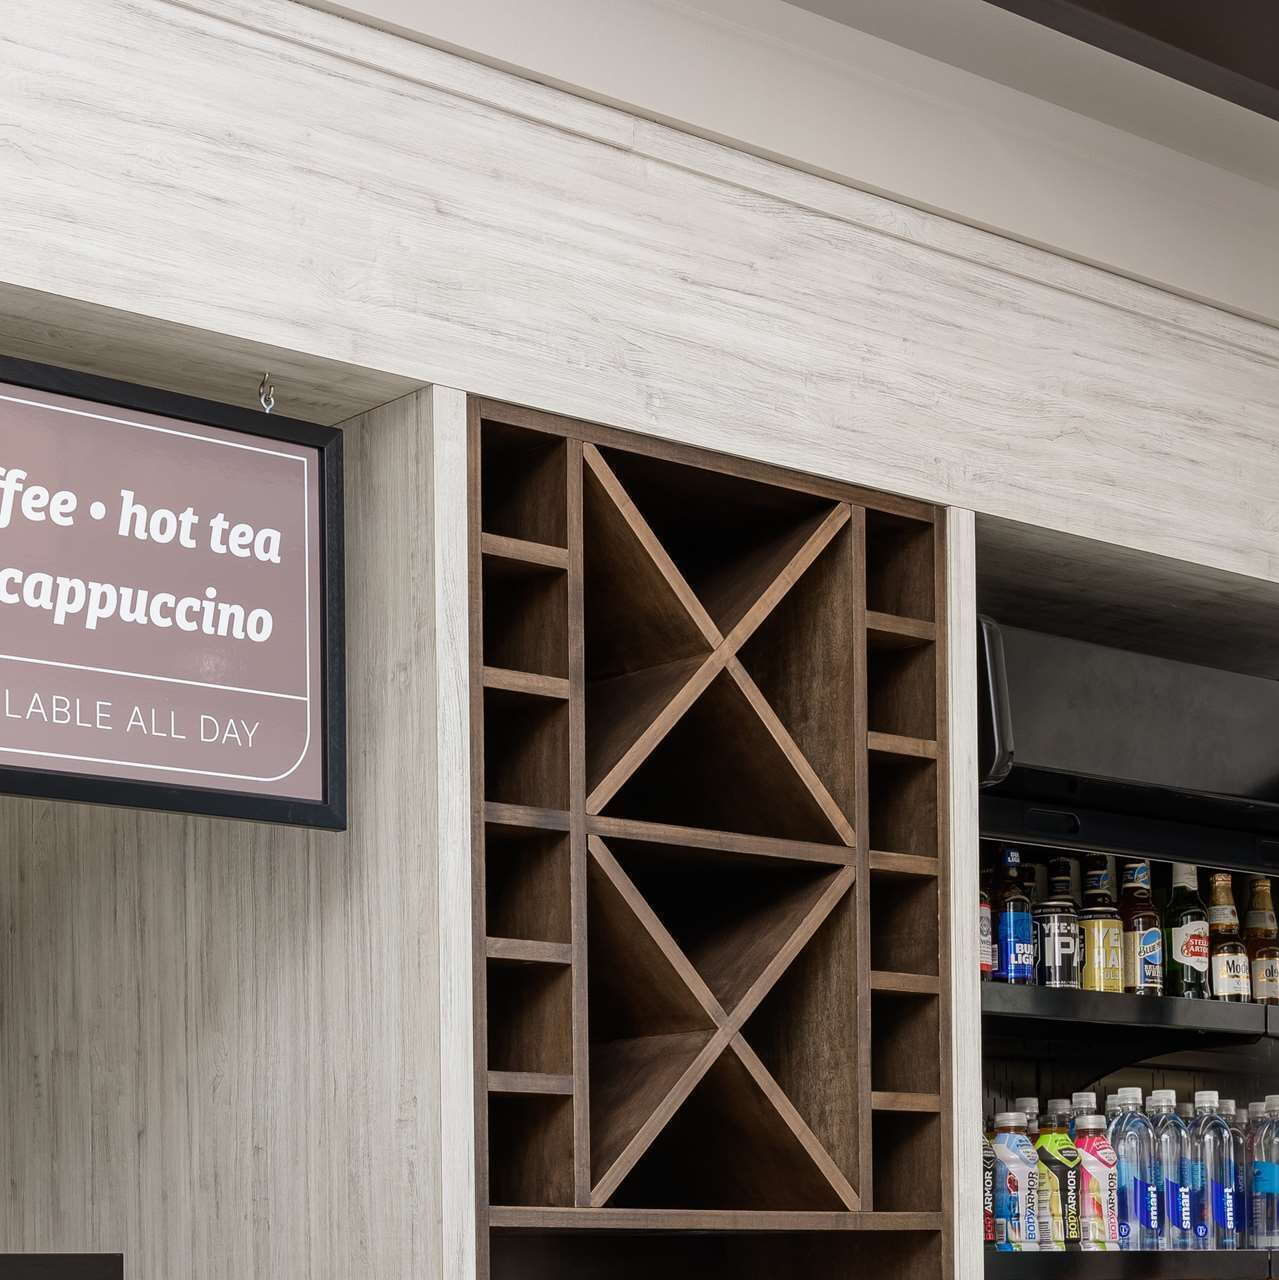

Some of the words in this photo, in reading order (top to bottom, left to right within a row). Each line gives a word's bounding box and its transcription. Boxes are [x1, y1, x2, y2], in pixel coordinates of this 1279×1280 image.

[117, 489, 201, 550] hot
[210, 512, 282, 565] tea
[125, 703, 188, 740] ALL
[200, 713, 261, 749] DAY
[1067, 1170, 1077, 1239] BODYARMOR
[1148, 1185, 1158, 1229] smart
[1179, 1186, 1190, 1229] smart
[1224, 1186, 1234, 1229] smart
